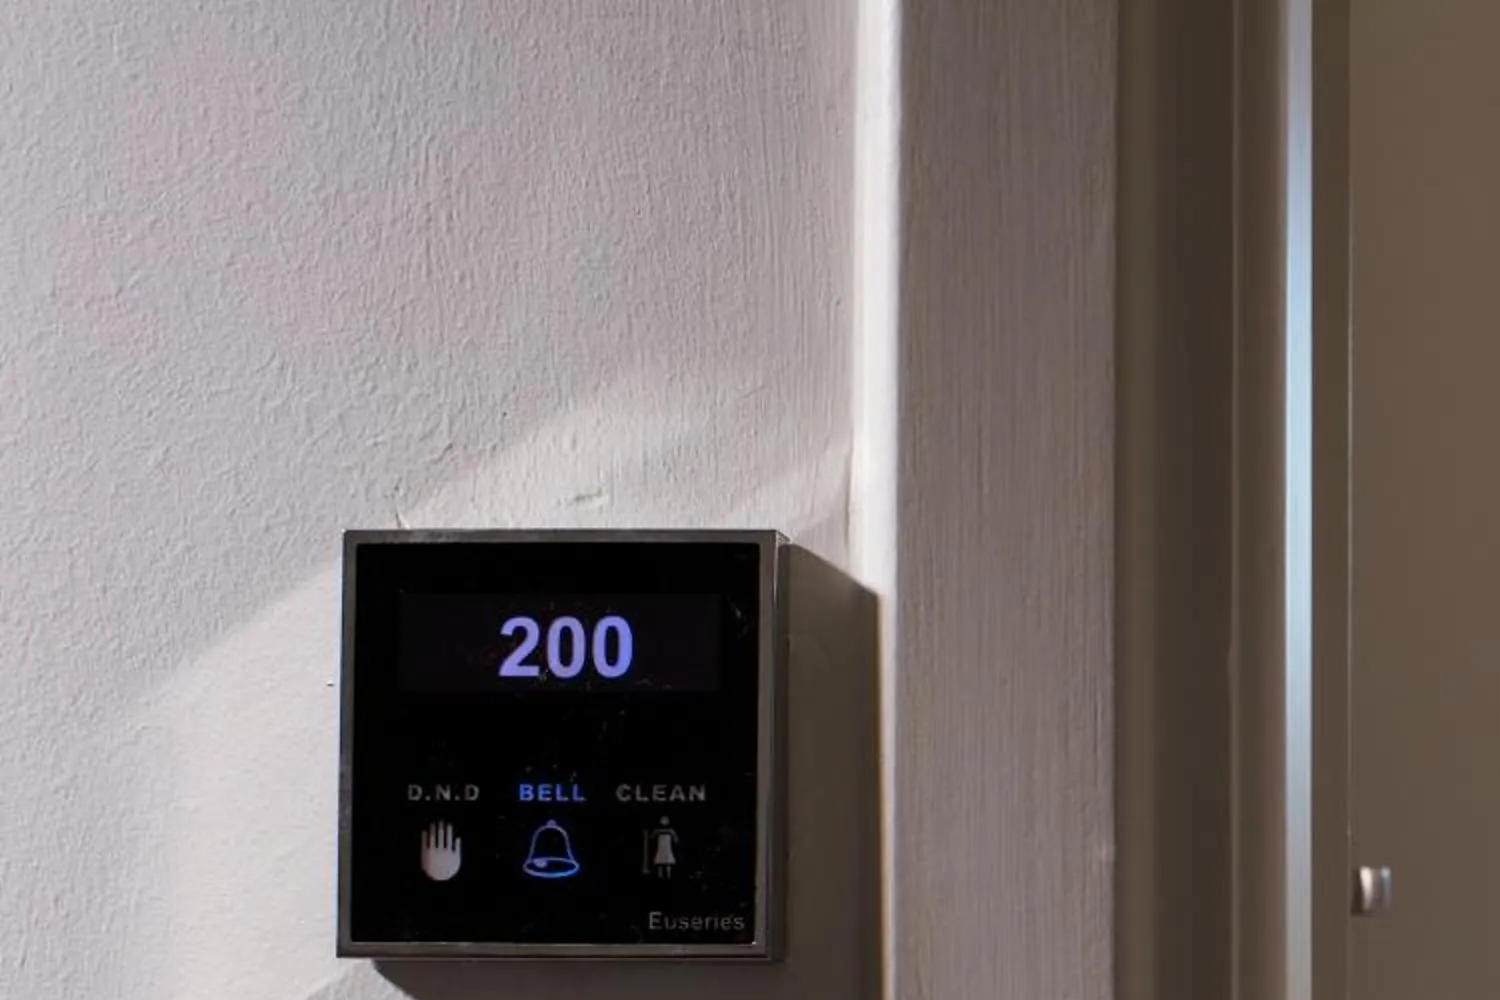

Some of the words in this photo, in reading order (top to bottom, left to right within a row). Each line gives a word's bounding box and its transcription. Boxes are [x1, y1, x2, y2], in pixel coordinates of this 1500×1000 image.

[498, 615, 634, 680] 200
[407, 783, 480, 802] D.N.D
[518, 783, 586, 802] BELL
[615, 783, 707, 802] CLEAN
[647, 910, 746, 931] Euseries
